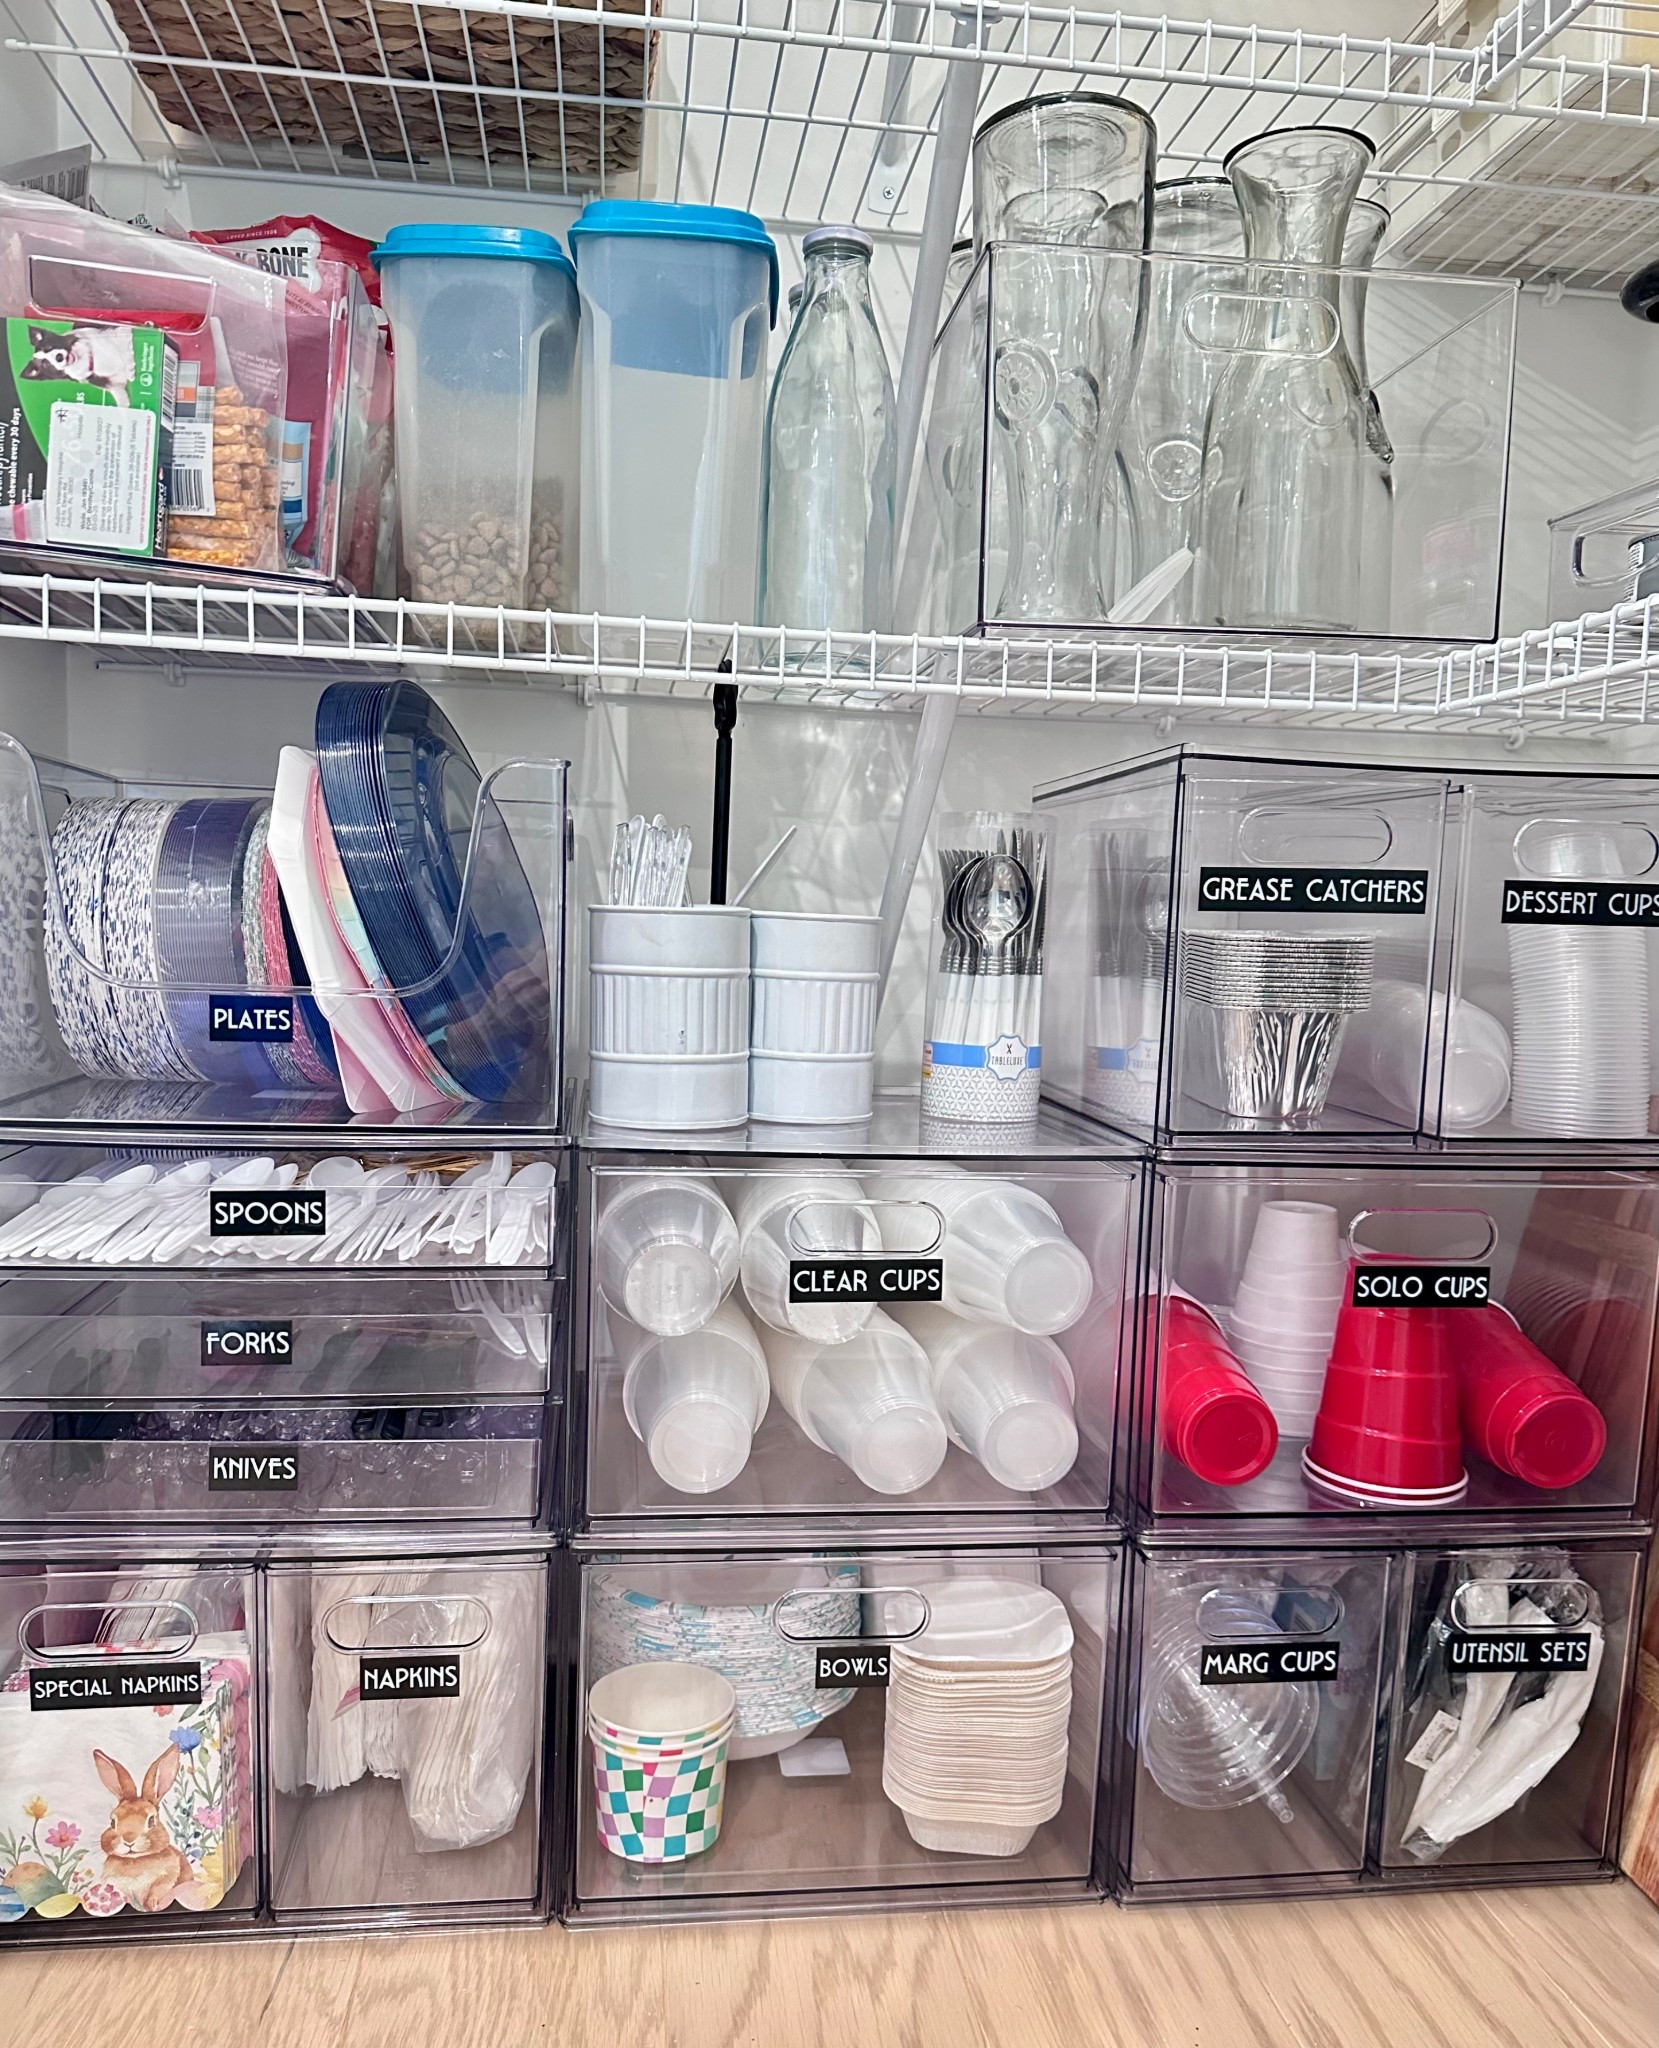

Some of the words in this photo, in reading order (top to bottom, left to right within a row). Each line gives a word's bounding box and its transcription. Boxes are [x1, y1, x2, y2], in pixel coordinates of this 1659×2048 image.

[10, 408, 22, 425] days
[10, 427, 19, 437] 30
[10, 438, 20, 460] every
[7, 461, 17, 498] chewable
[1203, 877, 1293, 901] GREASE
[1306, 879, 1423, 903] CATCHERS
[1506, 891, 1597, 914] DESSERT
[1609, 893, 1659, 916] CUPS
[215, 1009, 290, 1030] PLATES
[215, 1202, 322, 1224] SPOONS
[794, 1270, 867, 1292] CLEAR
[880, 1269, 939, 1291] CUPS
[1358, 1276, 1422, 1297] SOLO
[1435, 1277, 1487, 1298] CUPS
[207, 1332, 289, 1354] FORKS
[214, 1458, 295, 1479] KNIVES
[1204, 1653, 1268, 1674] MARG
[1281, 1651, 1335, 1672] CUPS
[1453, 1643, 1528, 1663] UTENSIL
[1541, 1642, 1586, 1662] SETS
[365, 1666, 457, 1689] NAPKINS
[820, 1658, 887, 1677] BOWLS
[35, 1679, 111, 1698] SPECIAL
[122, 1675, 199, 1694] NAPKINS
